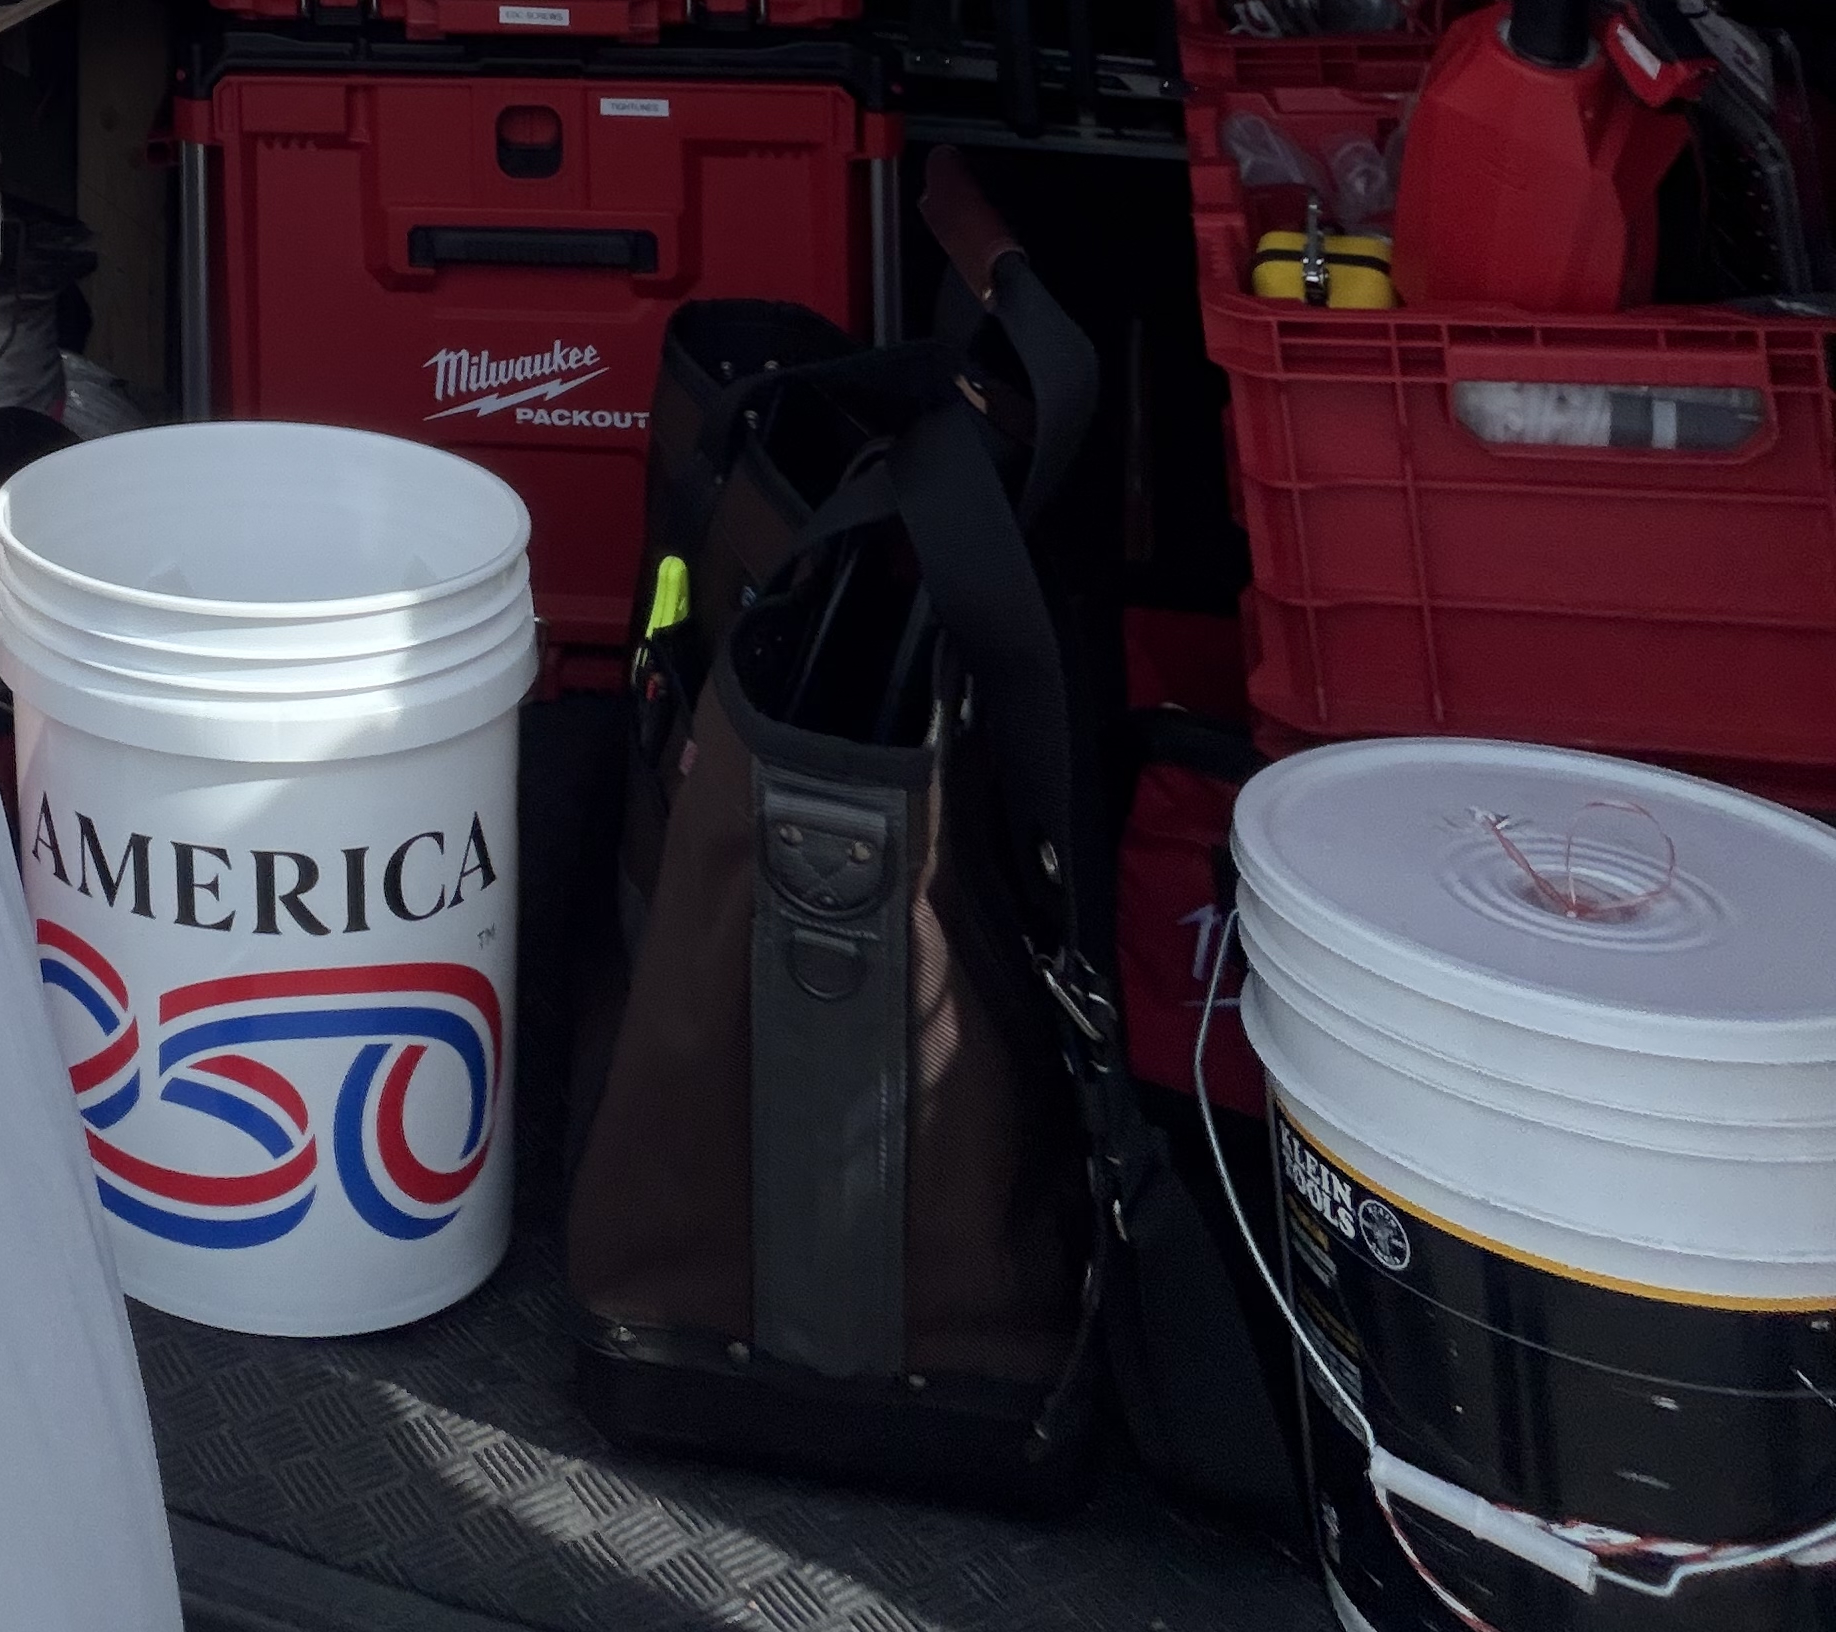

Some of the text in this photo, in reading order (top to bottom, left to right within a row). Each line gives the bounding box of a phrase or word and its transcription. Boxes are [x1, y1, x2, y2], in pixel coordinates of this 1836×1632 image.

[422, 339, 600, 401] Milwaukee
[515, 408, 650, 429] PACKOUT
[31, 790, 497, 936] AMERICA
[1278, 1119, 1354, 1212] KLEIN
